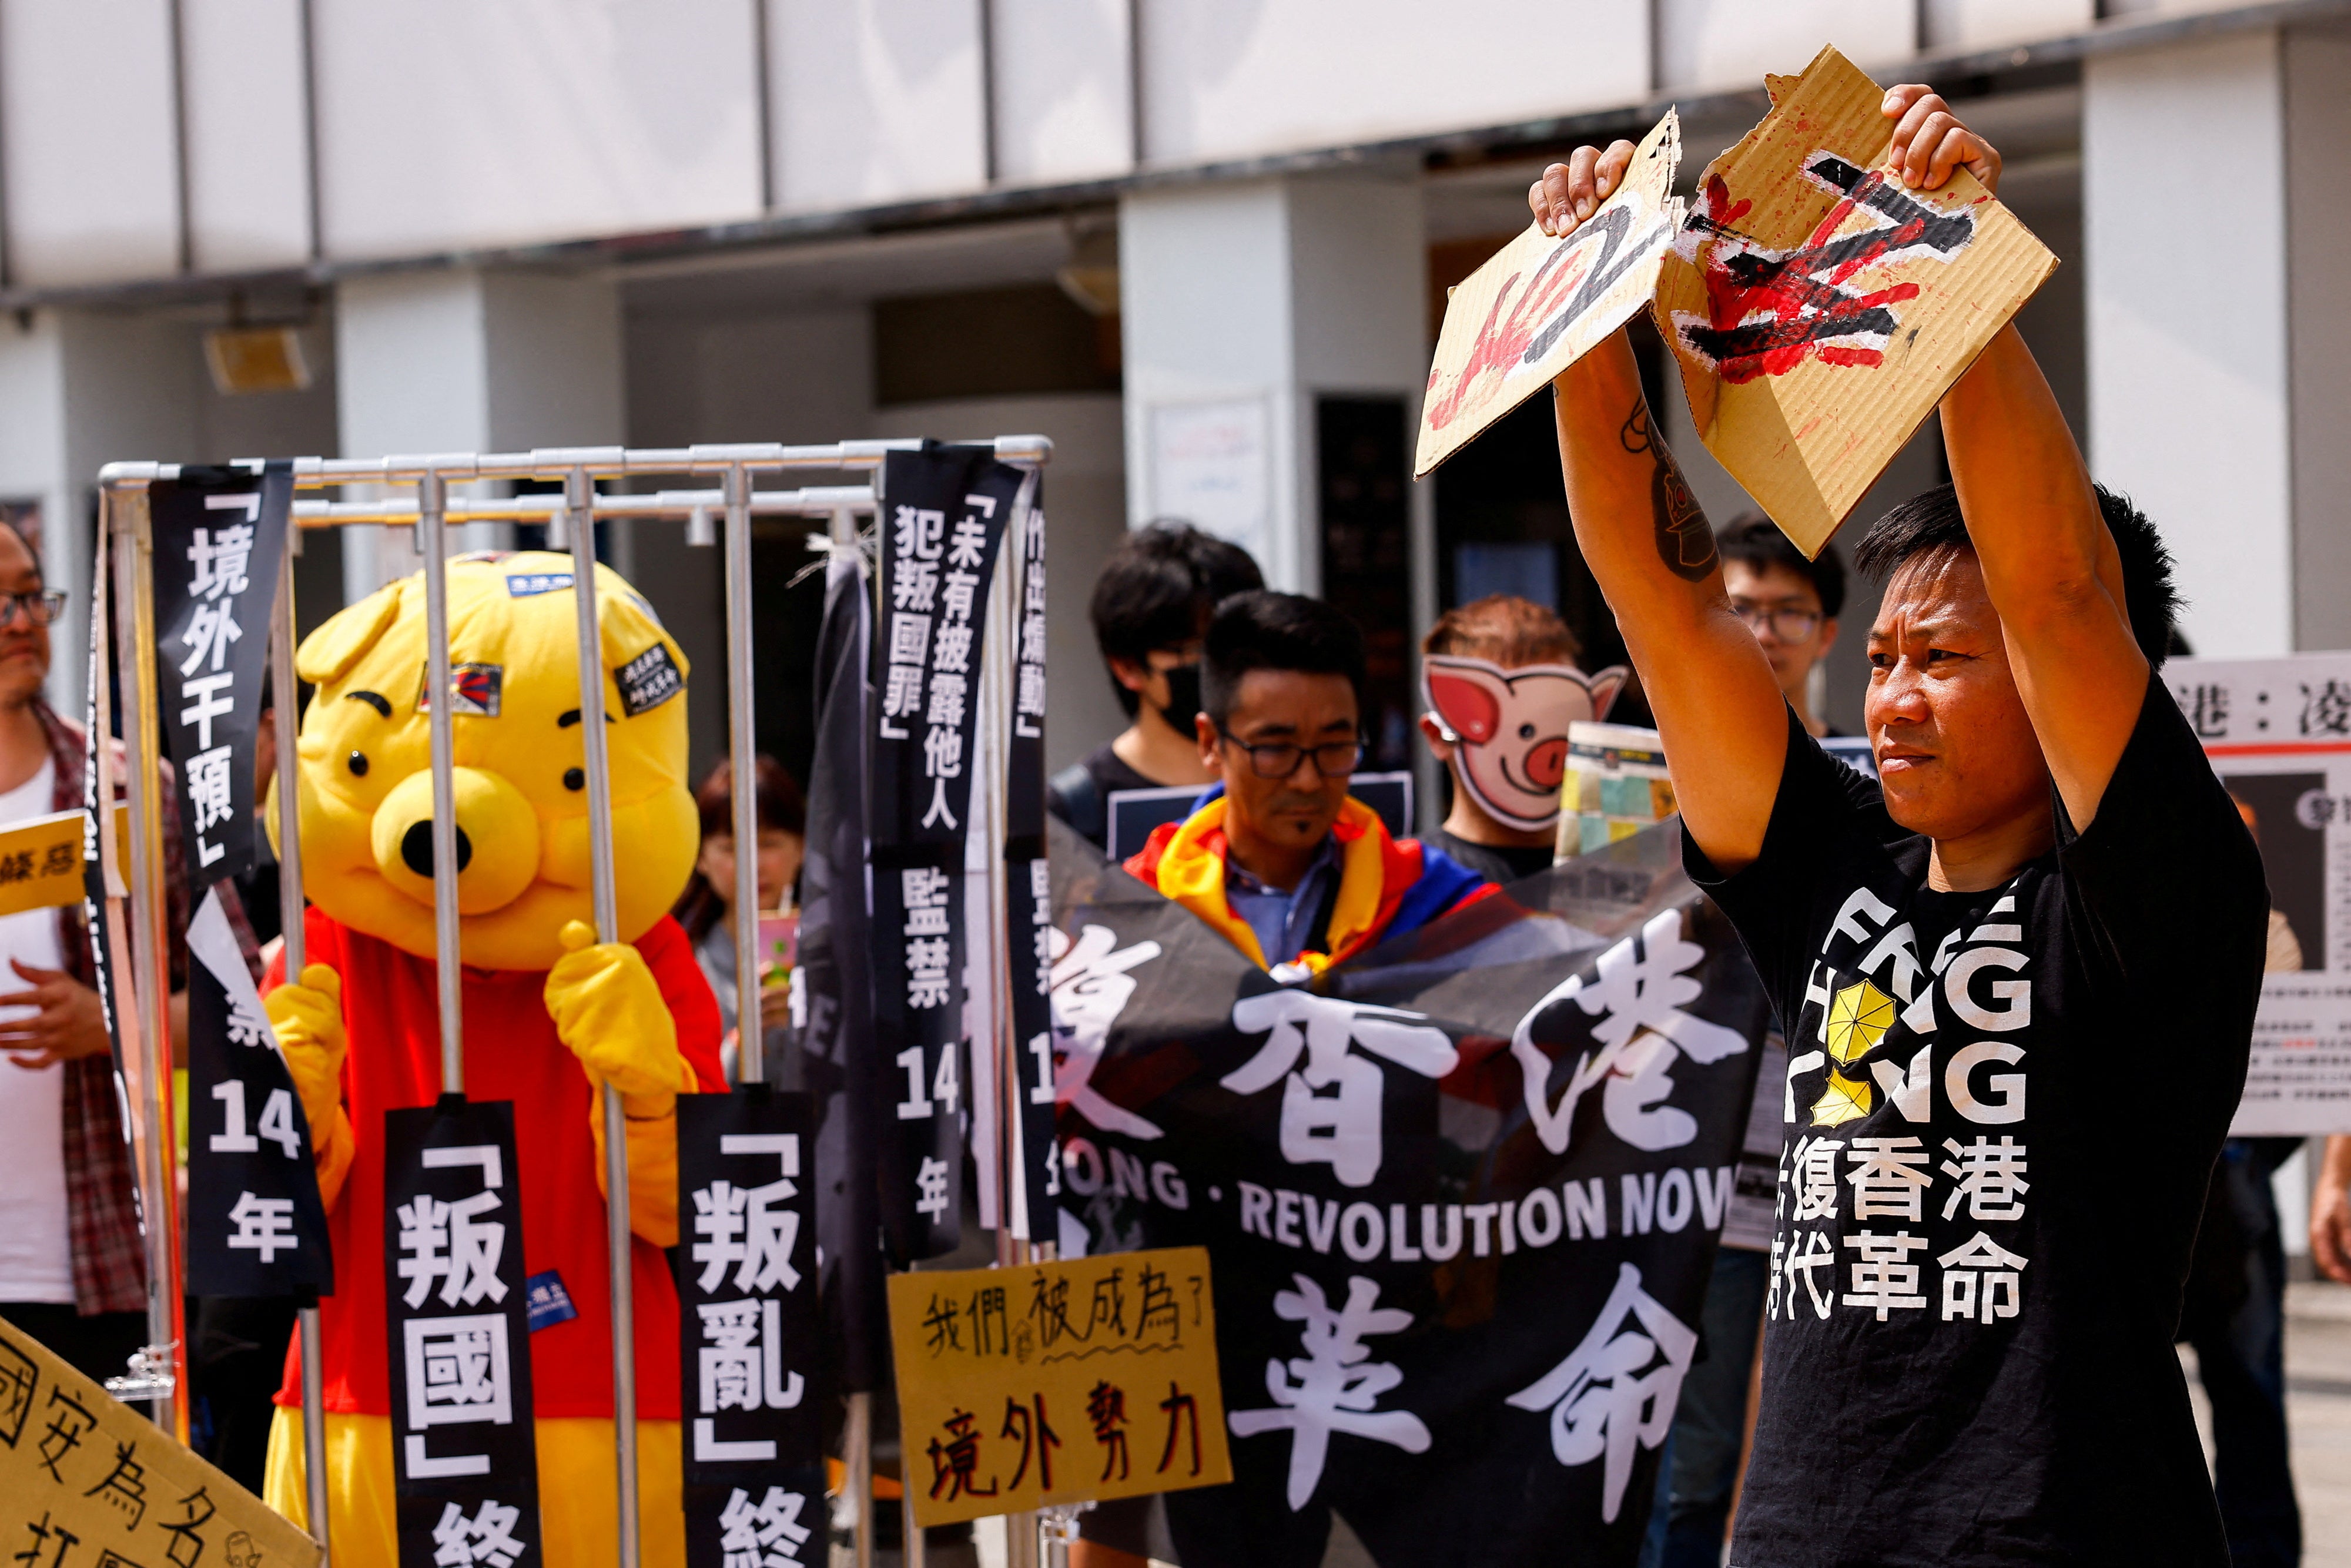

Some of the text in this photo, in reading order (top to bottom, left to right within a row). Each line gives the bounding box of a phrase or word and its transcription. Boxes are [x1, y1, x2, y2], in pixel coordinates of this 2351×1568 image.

[180, 492, 262, 869] 「境外干預」
[880, 504, 945, 741] 犯叛國罪」
[920, 493, 998, 830] 「未有披露他人
[210, 1079, 301, 1159] 14
[227, 1191, 298, 1263] 年
[1061, 1137, 1190, 1211] ONG
[1239, 1178, 1606, 1262] REVOLUTION
[922, 1262, 1203, 1359] 我們被成為了
[926, 1379, 1202, 1503] 境外勢力
[15, 1510, 147, 1568] 打
